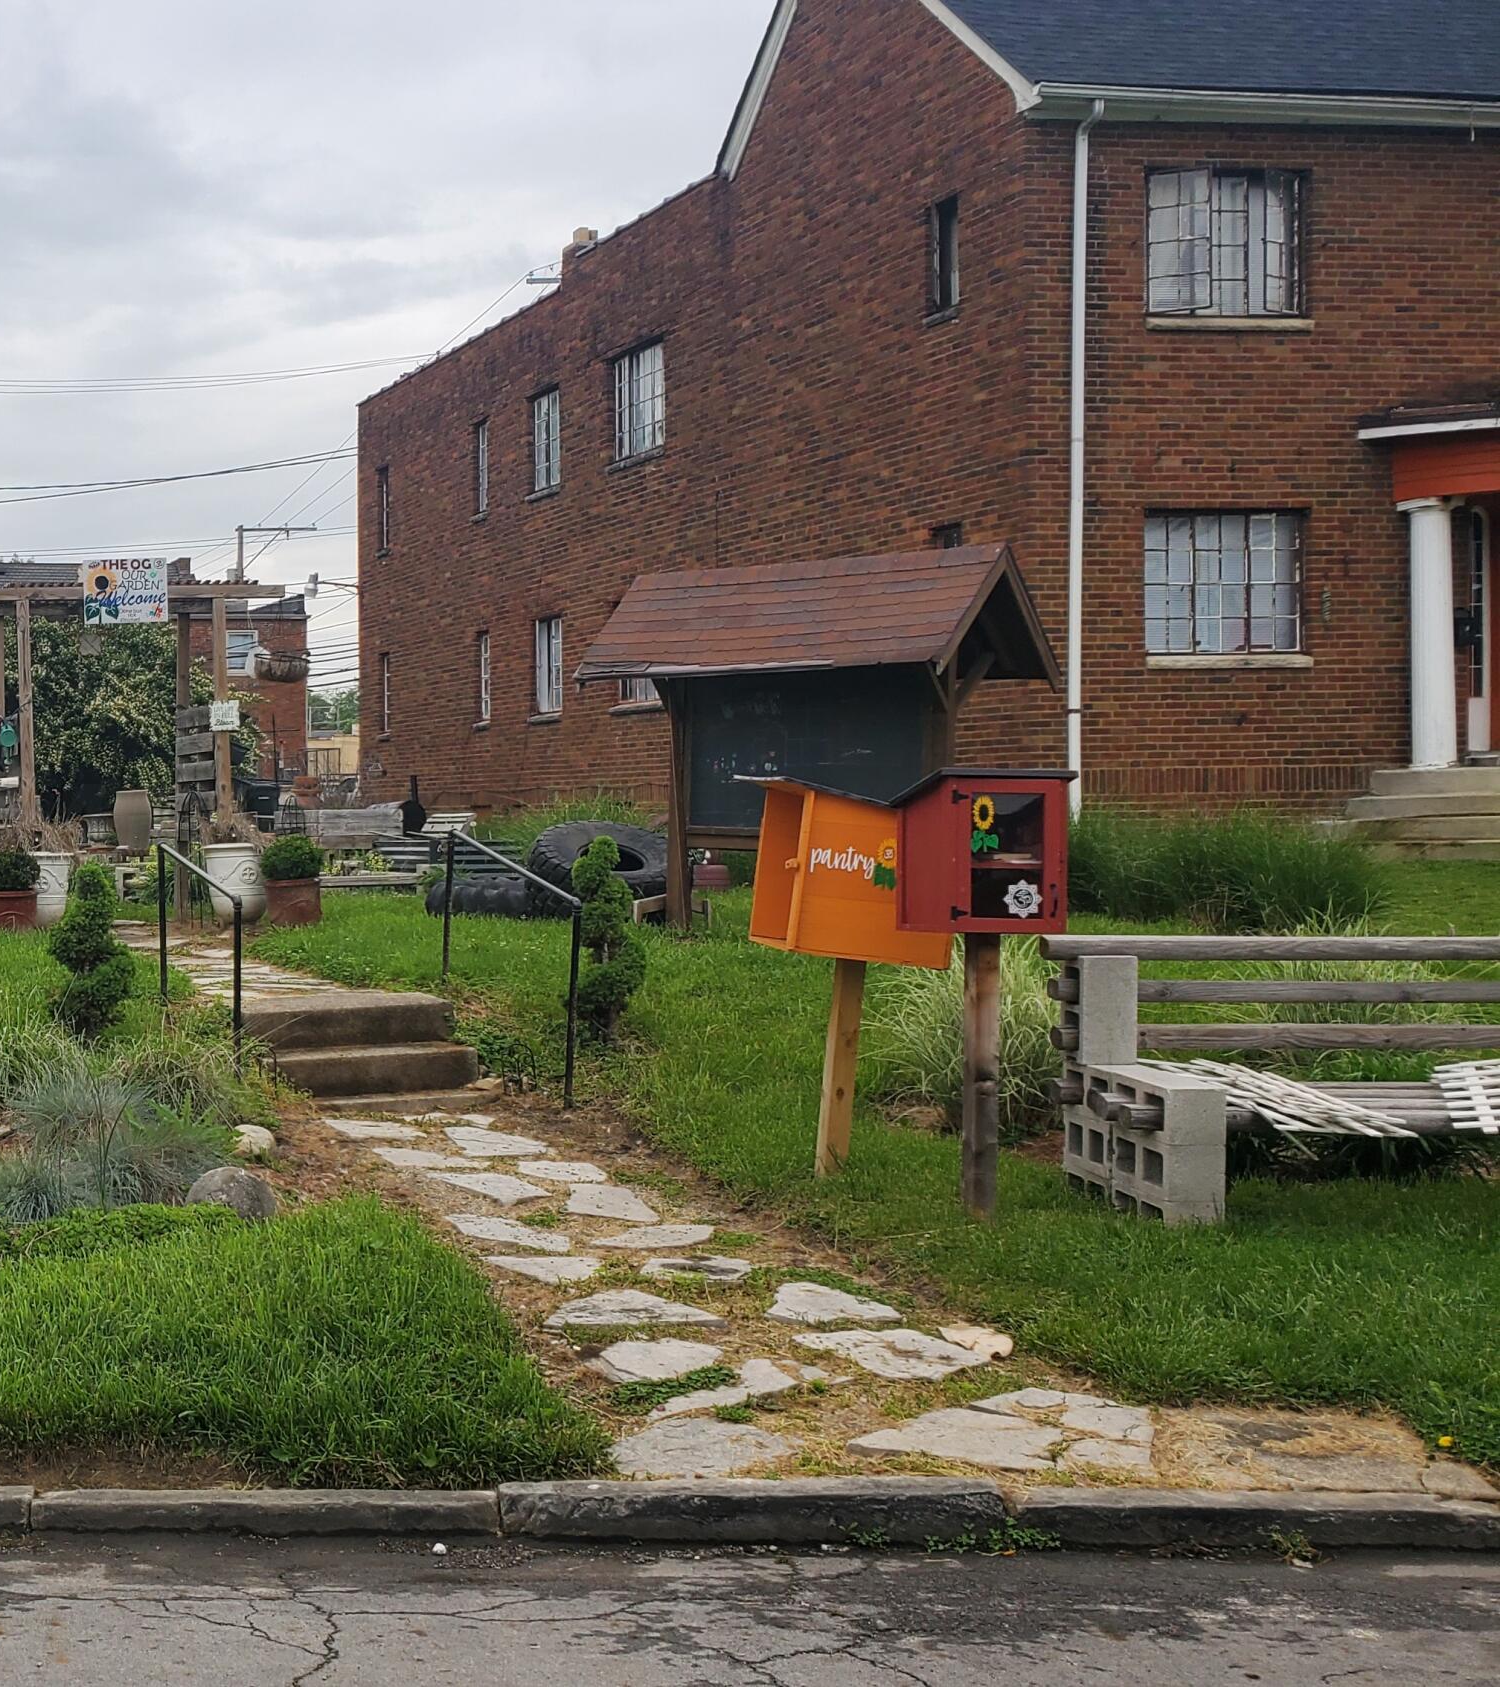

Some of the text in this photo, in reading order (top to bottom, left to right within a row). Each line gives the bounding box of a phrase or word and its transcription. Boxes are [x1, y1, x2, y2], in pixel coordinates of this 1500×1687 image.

[100, 559, 128, 570] THE
[130, 558, 152, 570] OG
[121, 570, 148, 581] OUR
[109, 579, 160, 591] GARDEN
[96, 589, 166, 609] Welcome
[810, 846, 876, 880] pantry
